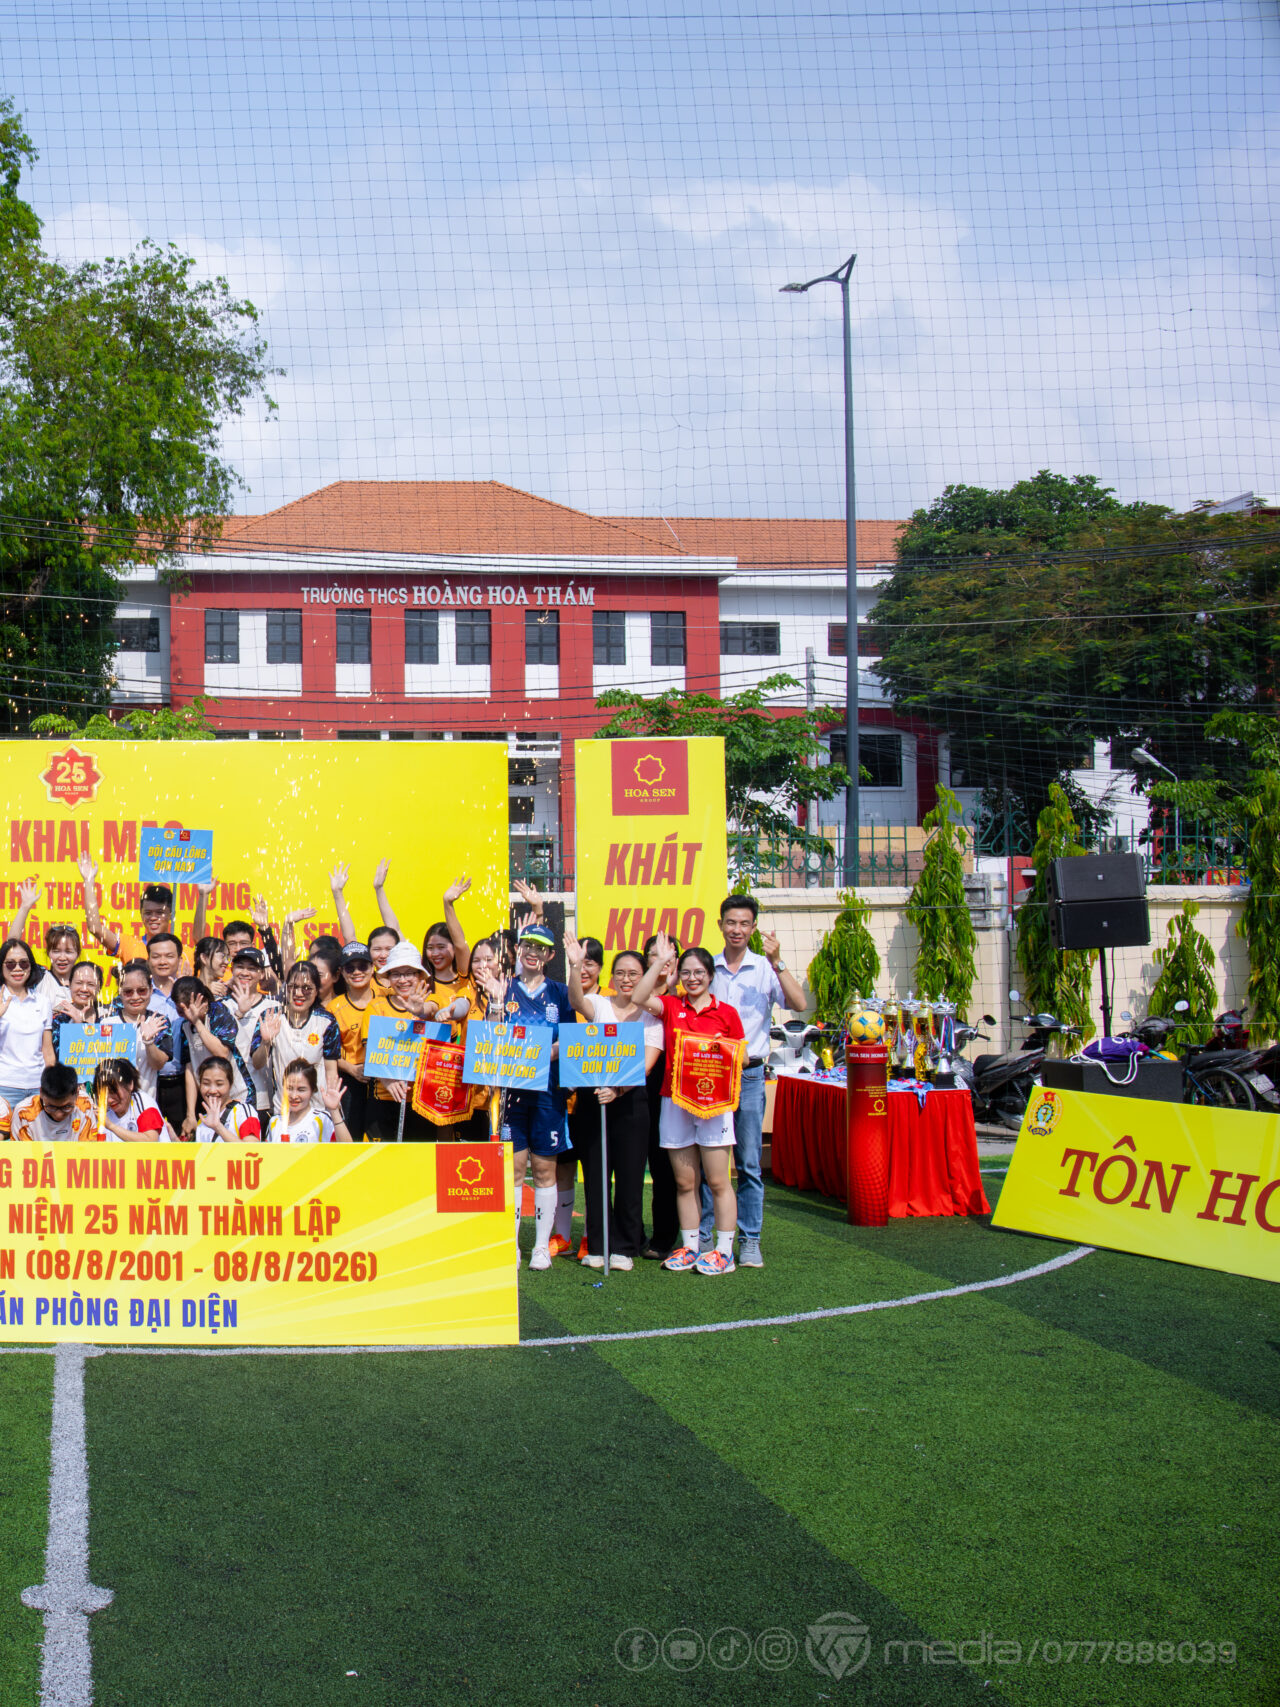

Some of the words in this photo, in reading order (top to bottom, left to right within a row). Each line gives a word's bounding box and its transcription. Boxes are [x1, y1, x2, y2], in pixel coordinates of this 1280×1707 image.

[302, 583, 365, 604] TRƯỜNG
[368, 587, 408, 604] THCS
[413, 579, 483, 605] HOÀNG
[488, 586, 530, 605] HOA
[534, 580, 595, 606] THÁM
[57, 762, 86, 784] 25
[624, 789, 649, 798] HOA
[652, 788, 676, 797] SEN
[11, 821, 89, 862] KHAI
[148, 845, 162, 859] ĐỘI
[184, 846, 207, 859] LÔNG
[604, 831, 702, 885] KHÁT
[174, 861, 195, 872] NAM
[111, 882, 171, 910] CH
[69, 1038, 85, 1056] ĐỘI
[87, 1039, 112, 1054] BÓNG
[114, 1038, 129, 1053] NỮ
[378, 1036, 396, 1052] ĐỘI
[475, 1041, 492, 1057] ĐỘI
[495, 1043, 522, 1058] BÓNG
[525, 1045, 542, 1060] NỮ
[567, 1042, 584, 1060] ĐỘI
[610, 1042, 637, 1058] LÔNG
[369, 1052, 389, 1066] HOA
[391, 1054, 411, 1068] SEN
[582, 1058, 601, 1074] ĐƠN
[603, 1058, 621, 1073] NỮ
[500, 1063, 537, 1080] DƯƠNG
[550, 1131, 559, 1147] 5
[23, 1152, 55, 1189] ĐÁ
[67, 1159, 125, 1189] MINI
[137, 1160, 196, 1190] NAM
[228, 1153, 263, 1190] NỮ
[1059, 1135, 1191, 1214] TÔN
[448, 1188, 471, 1197] HOA
[473, 1187, 494, 1196] SEN
[9, 1197, 74, 1241] NIỆM
[85, 1205, 119, 1235] 25
[129, 1198, 188, 1236] NĂM
[199, 1199, 283, 1236] THÀNH
[294, 1199, 341, 1243] LẬP
[27, 1249, 183, 1281] (08/8/2001
[214, 1251, 378, 1282] 08/8/2026)
[36, 1291, 118, 1327] PHÒNG
[129, 1298, 171, 1334] ĐẠI
[183, 1293, 238, 1335] DIỆN
